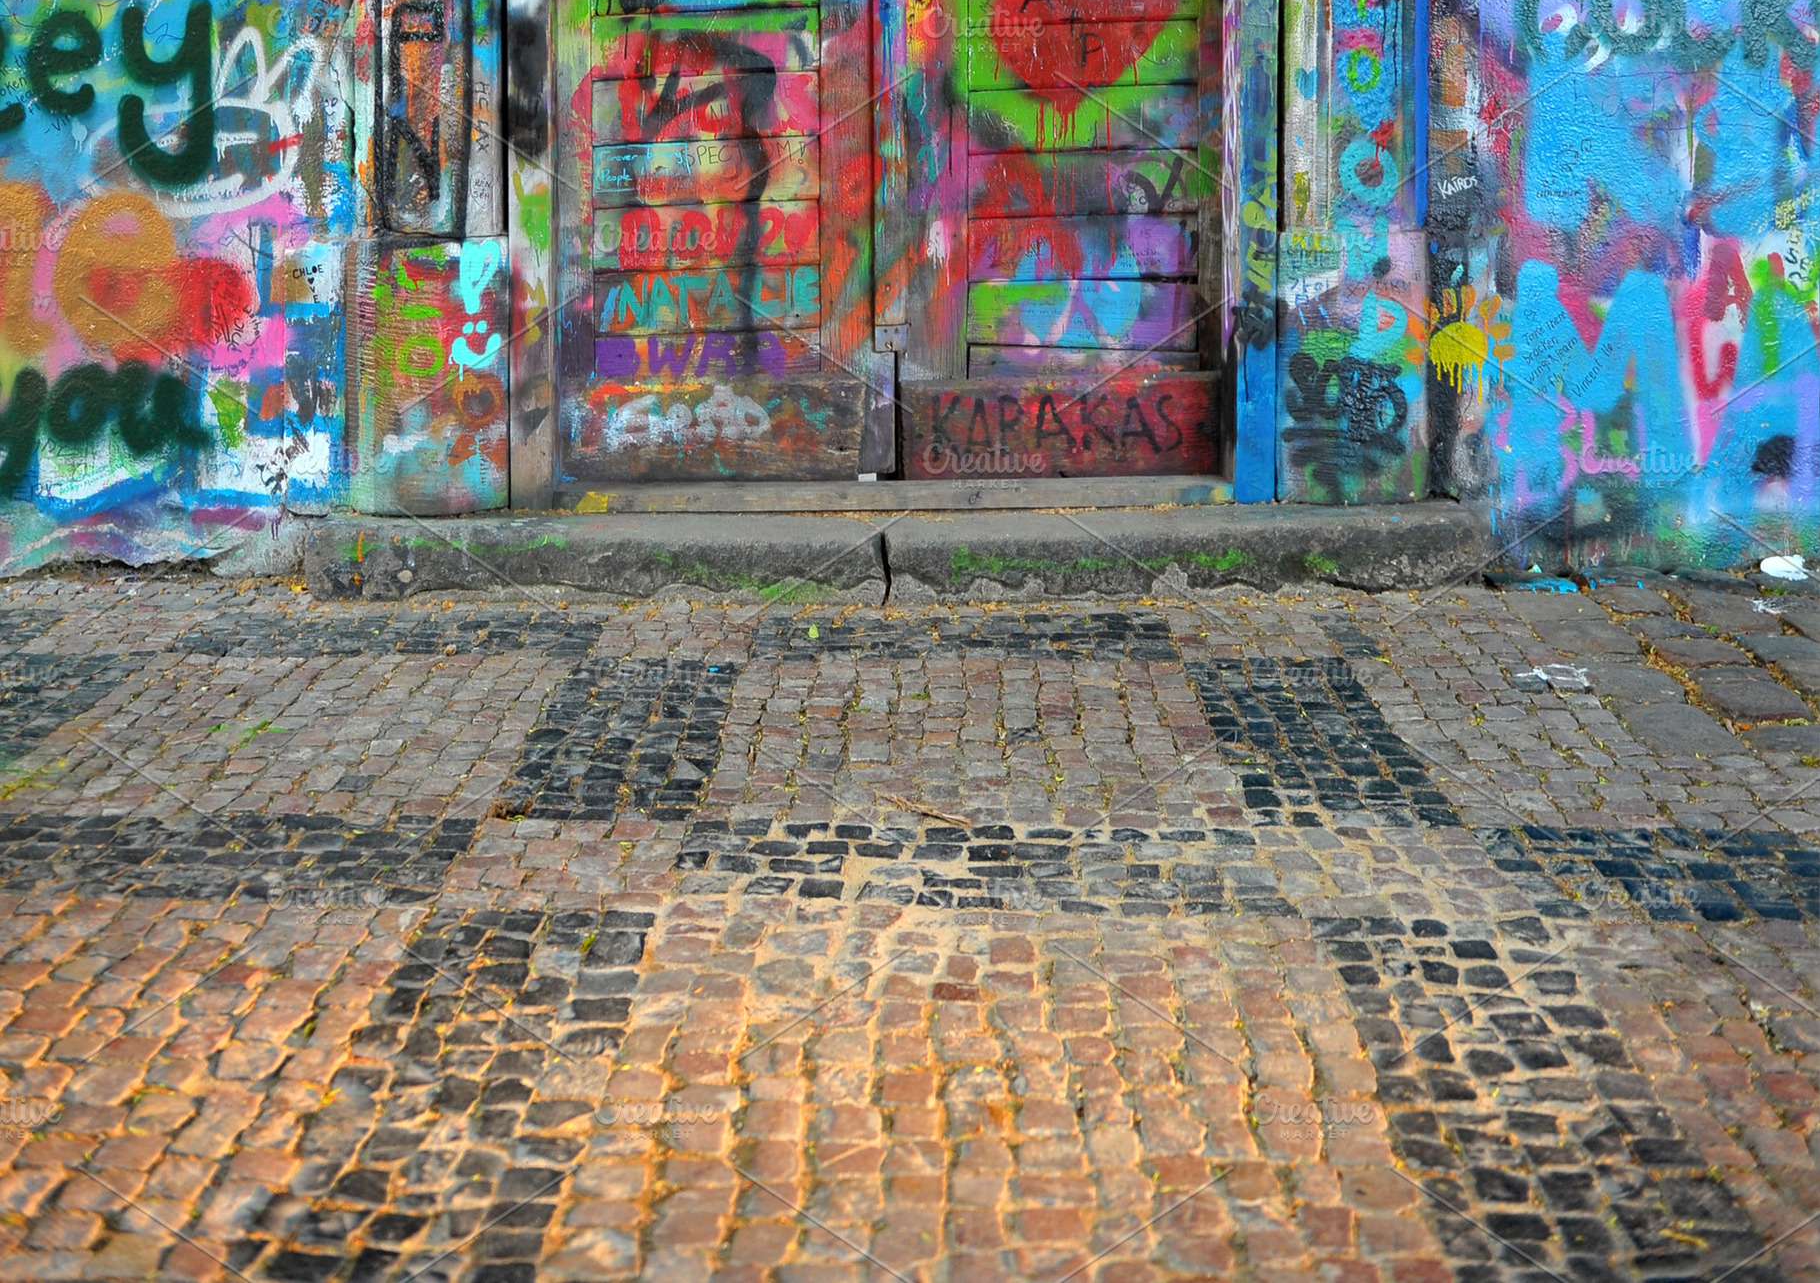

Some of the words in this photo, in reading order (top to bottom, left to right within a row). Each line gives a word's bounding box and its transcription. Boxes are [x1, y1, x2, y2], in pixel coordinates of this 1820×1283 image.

[1081, 31, 1104, 67] P
[292, 263, 324, 281] CHLOE
[616, 266, 820, 322] NATALIE
[931, 392, 1184, 463] KARAKAS
